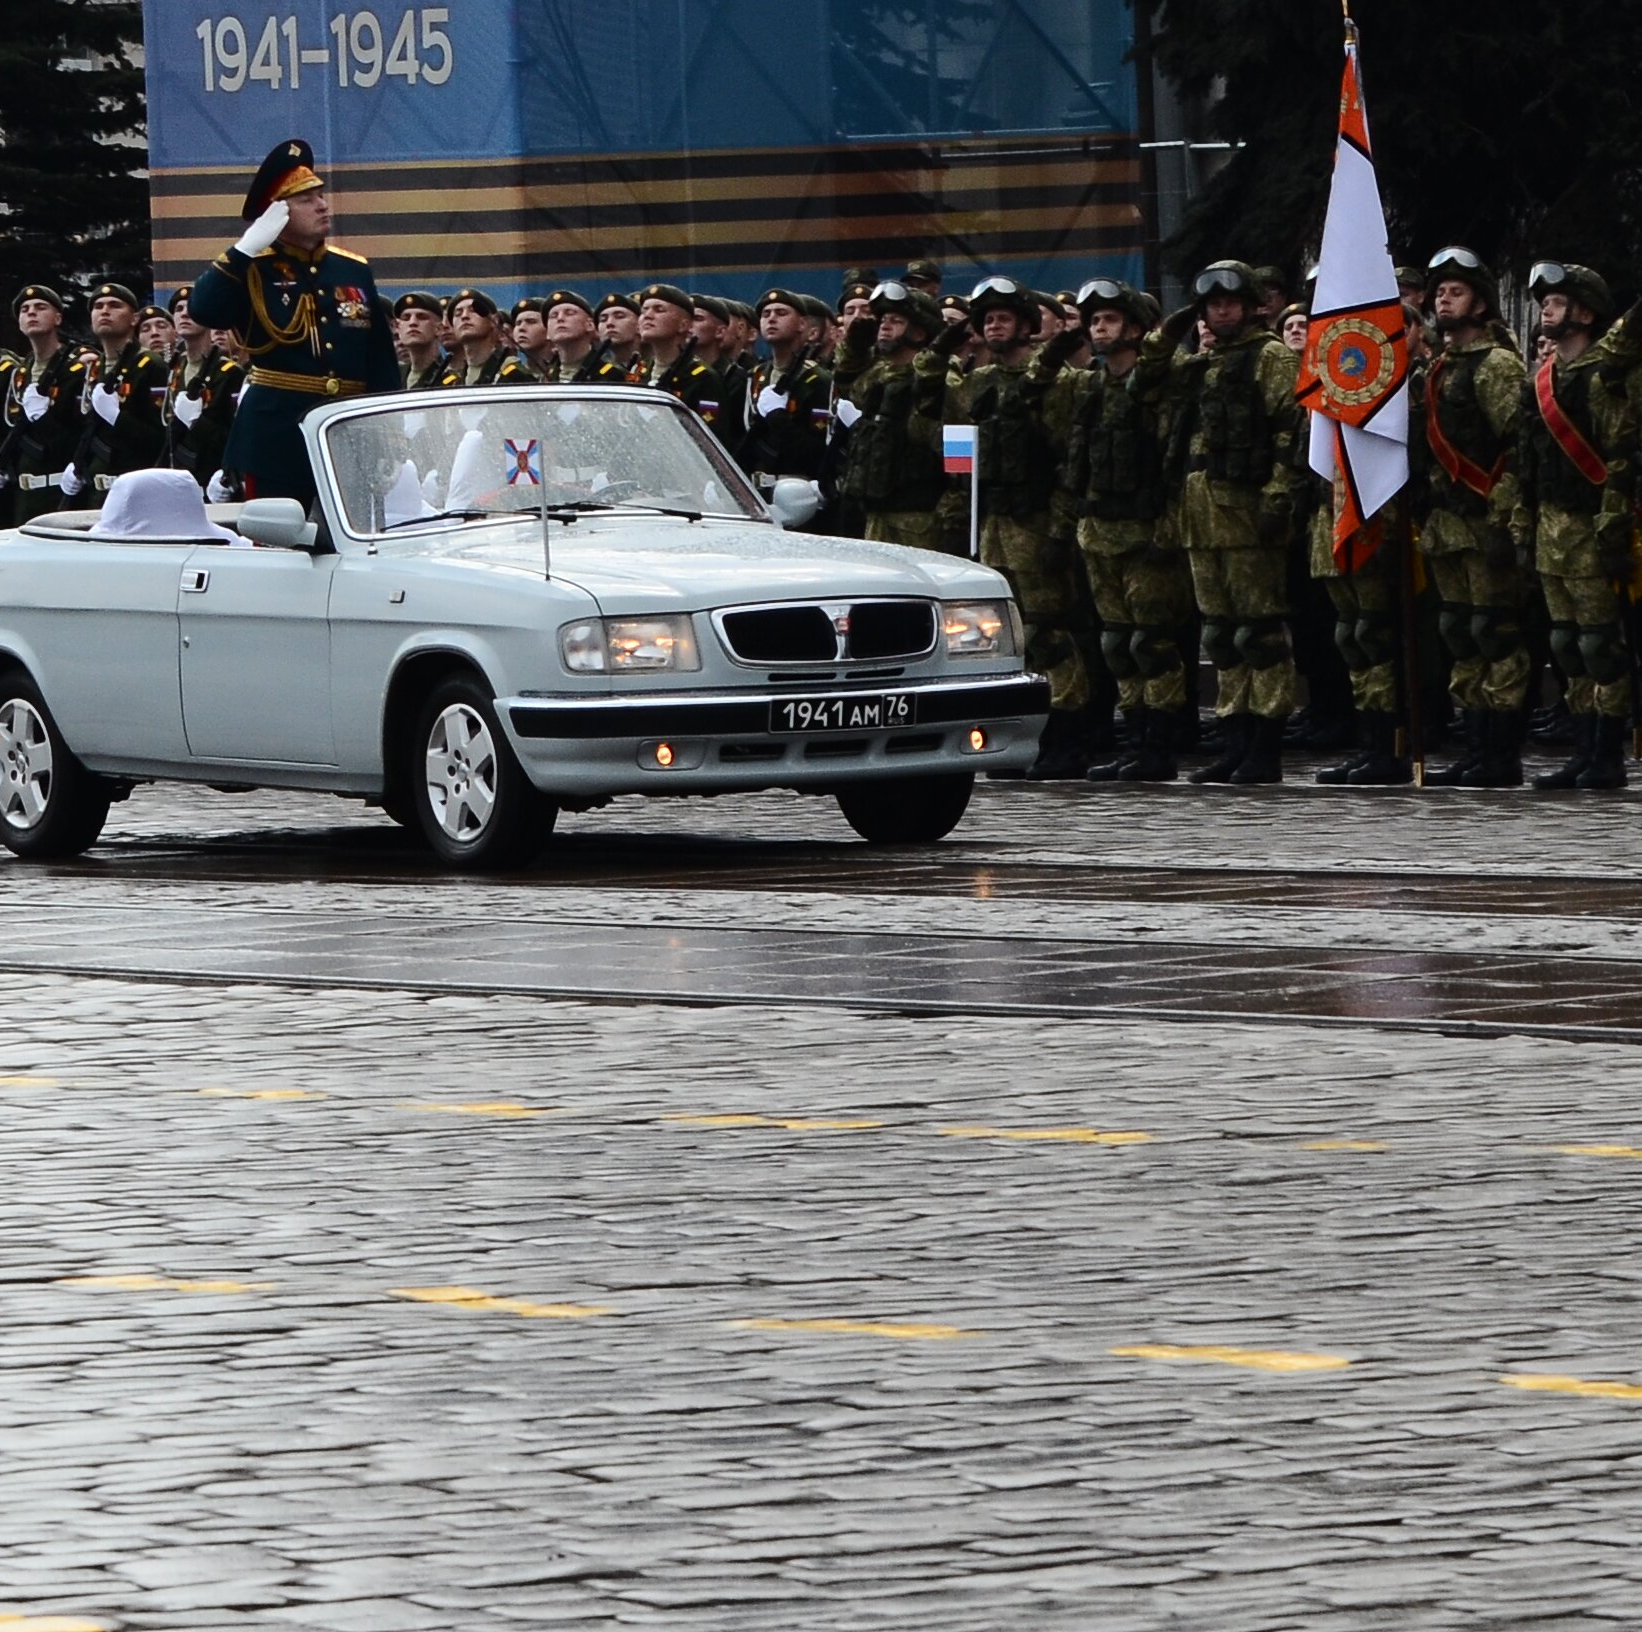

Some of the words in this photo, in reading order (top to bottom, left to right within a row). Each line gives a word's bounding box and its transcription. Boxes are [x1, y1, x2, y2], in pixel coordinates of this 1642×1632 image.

[196, 8, 453, 92] 1941-1945
[783, 700, 844, 728] 1941
[886, 695, 909, 716] 76
